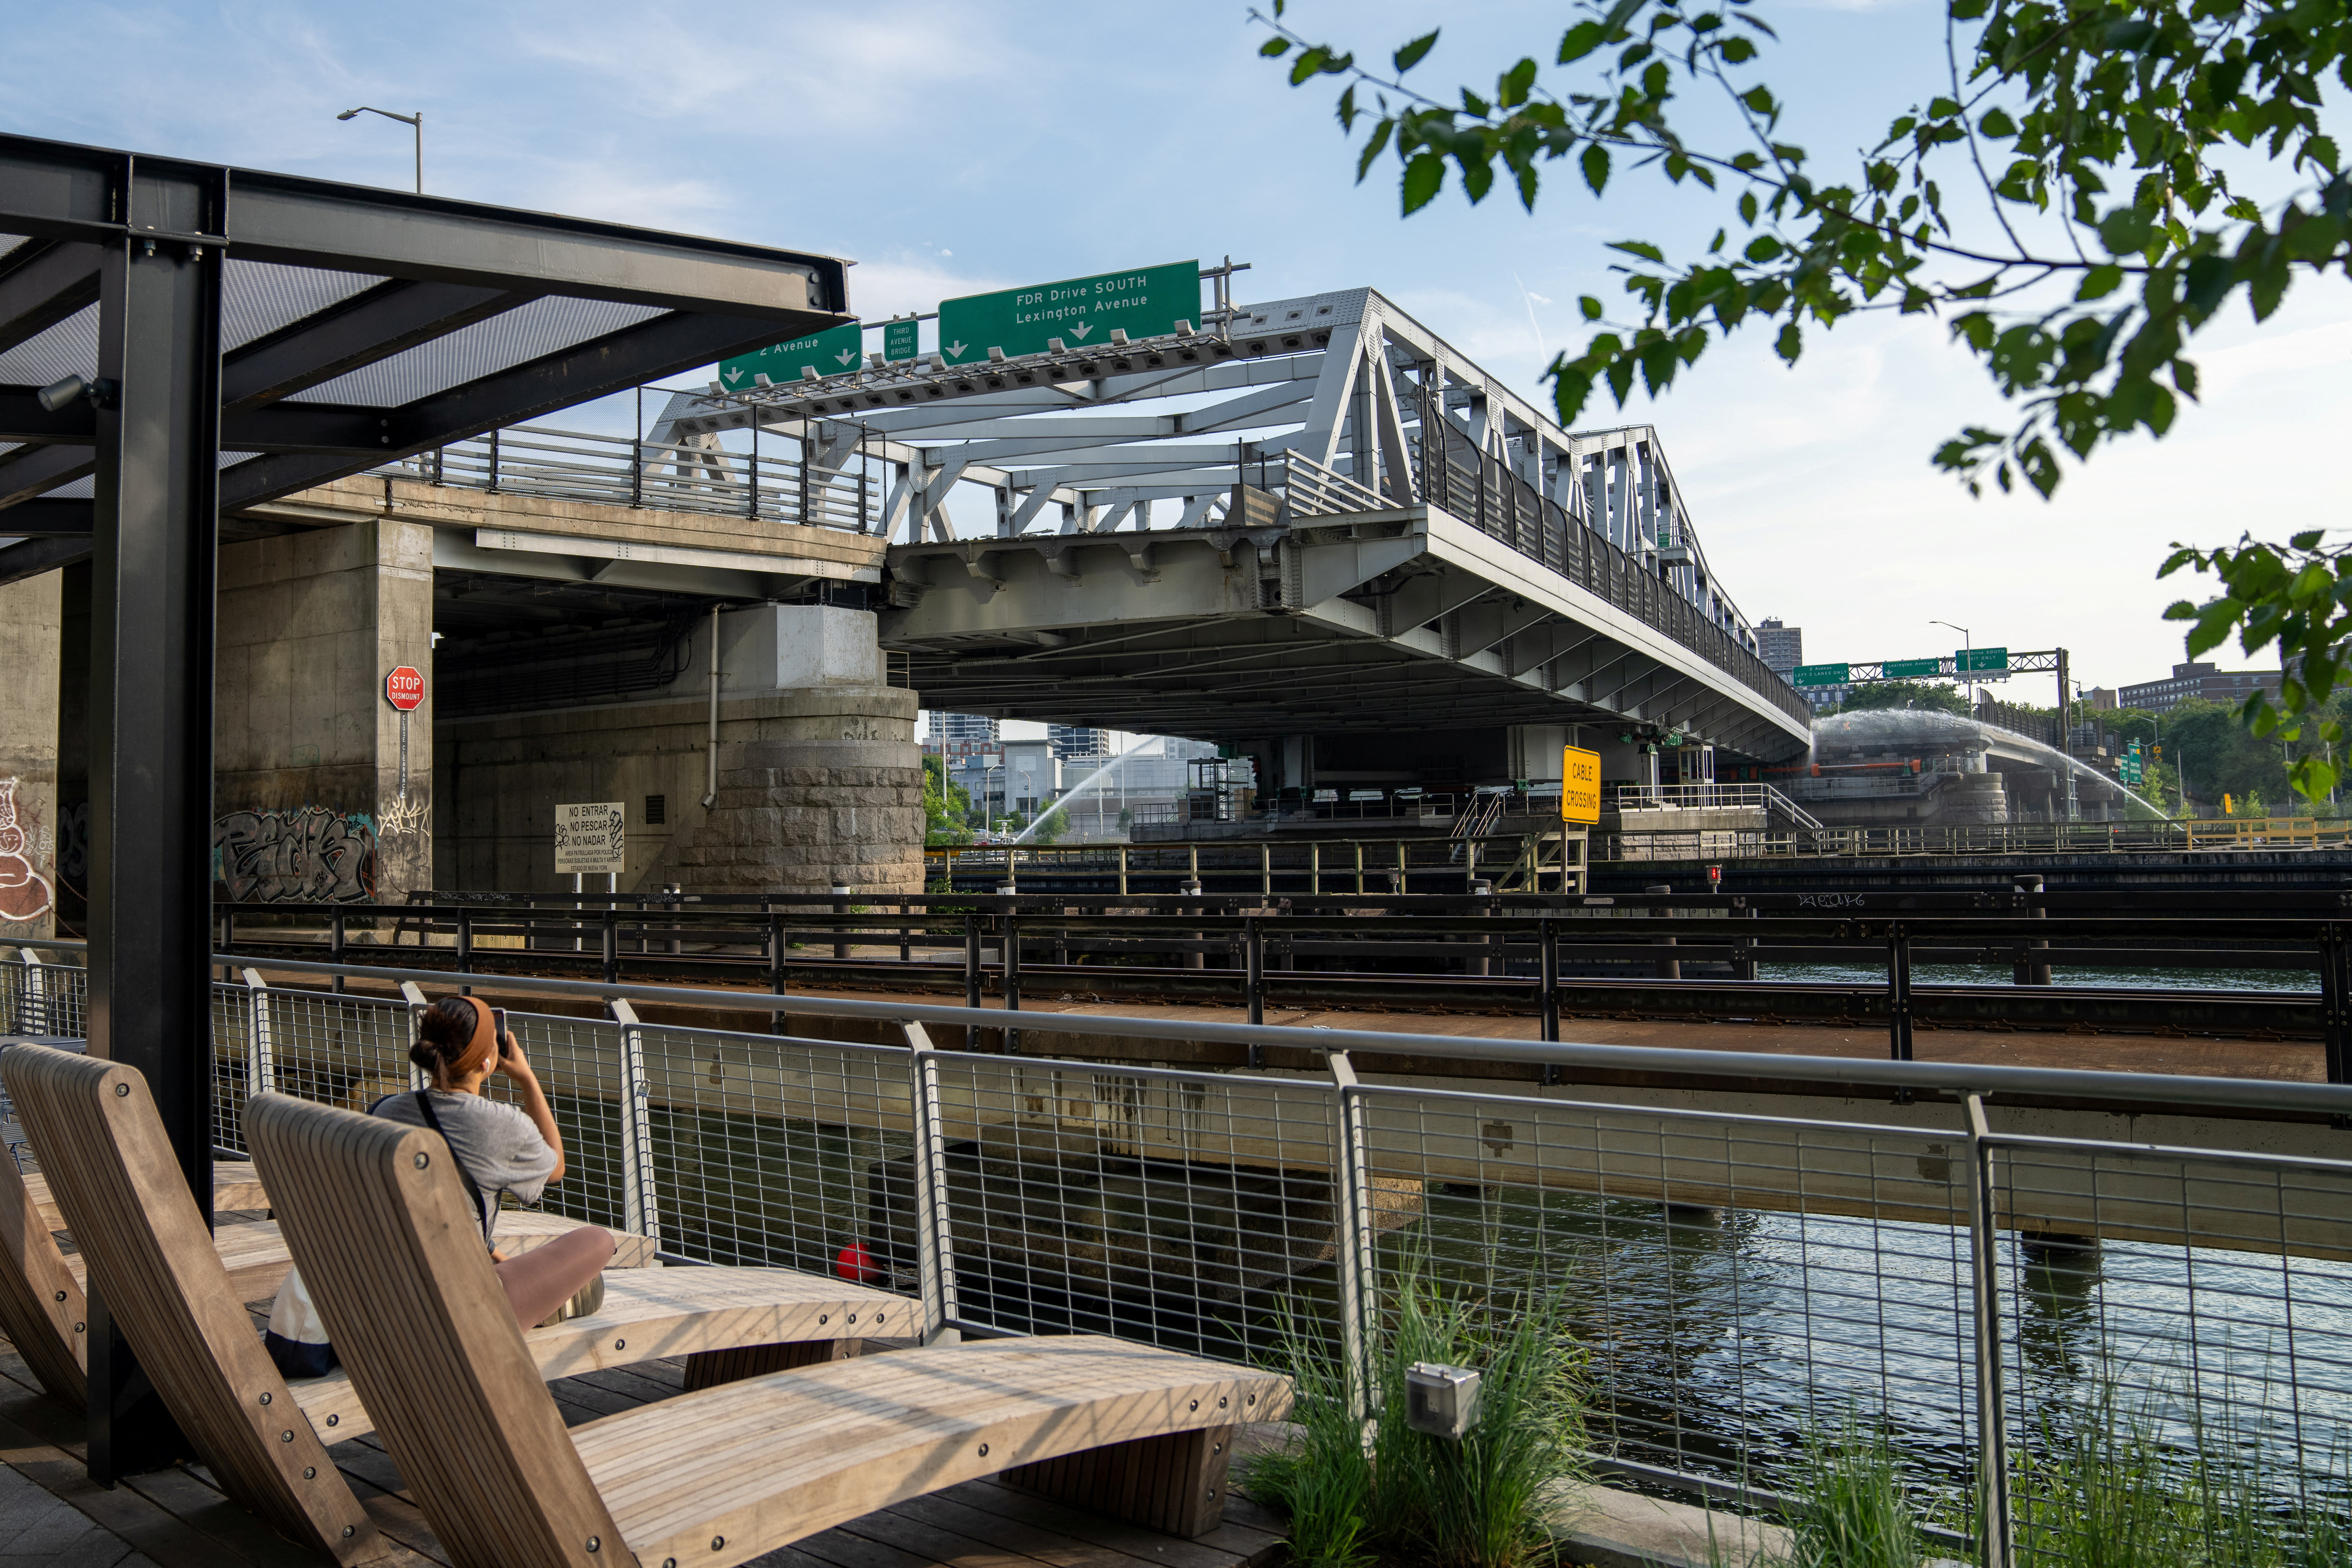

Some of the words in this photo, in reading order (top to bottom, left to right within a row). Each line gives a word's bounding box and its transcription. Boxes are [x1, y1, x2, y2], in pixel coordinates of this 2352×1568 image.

[1017, 292, 1043, 306] FDR
[1050, 287, 1087, 301] Drive
[1095, 276, 1147, 294] SOUTH
[1017, 305, 1086, 324] Lexington
[1095, 296, 1147, 312] Avenue
[774, 339, 818, 353] Avenue
[890, 336, 912, 345] AVENUE
[891, 346, 911, 355] BRIDGE
[392, 676, 420, 690] STOP
[1573, 763, 1592, 781] CABLE
[1567, 789, 1596, 809] CROSSING
[569, 807, 579, 817] NO
[582, 805, 608, 816] ENTRAR
[570, 821, 580, 832] NO
[581, 820, 607, 831] PESCAR
[572, 836, 581, 846] NO
[583, 835, 606, 846] NADAR
